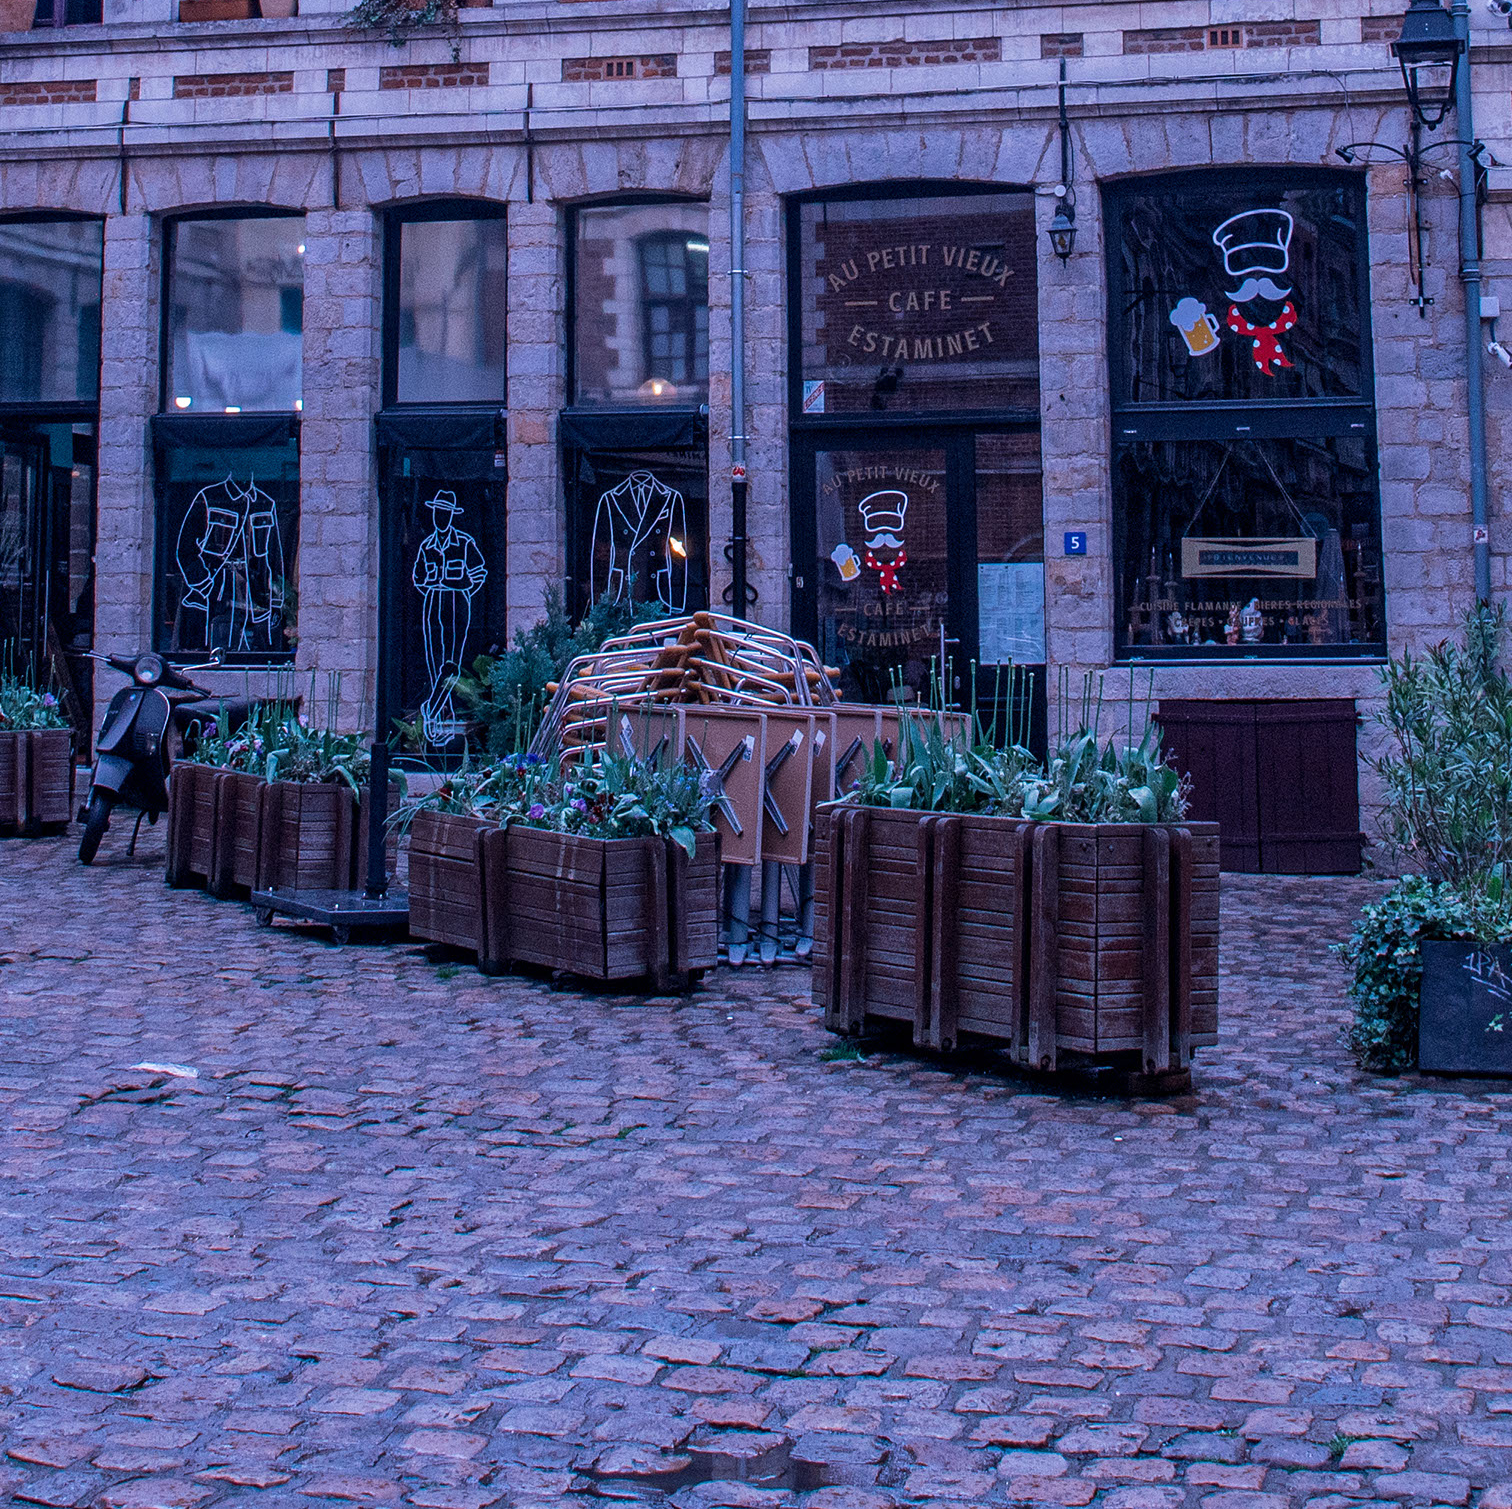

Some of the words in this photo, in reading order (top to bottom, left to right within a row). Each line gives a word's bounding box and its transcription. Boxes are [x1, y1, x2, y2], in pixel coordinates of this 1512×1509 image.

[828, 259, 859, 293] AU
[866, 245, 931, 272] PETIT
[942, 246, 1015, 287] VIEUX
[889, 290, 952, 312] CAFE
[847, 322, 994, 359] ESTAMINET
[822, 475, 842, 495] AU
[847, 466, 888, 483] PETIT
[895, 466, 941, 494] VIEUX
[1071, 536, 1080, 549] 5
[796, 576, 804, 588] 5
[863, 602, 905, 616] CAFE
[1140, 601, 1180, 612] CUISINE
[837, 622, 930, 647] ESTAMINET
